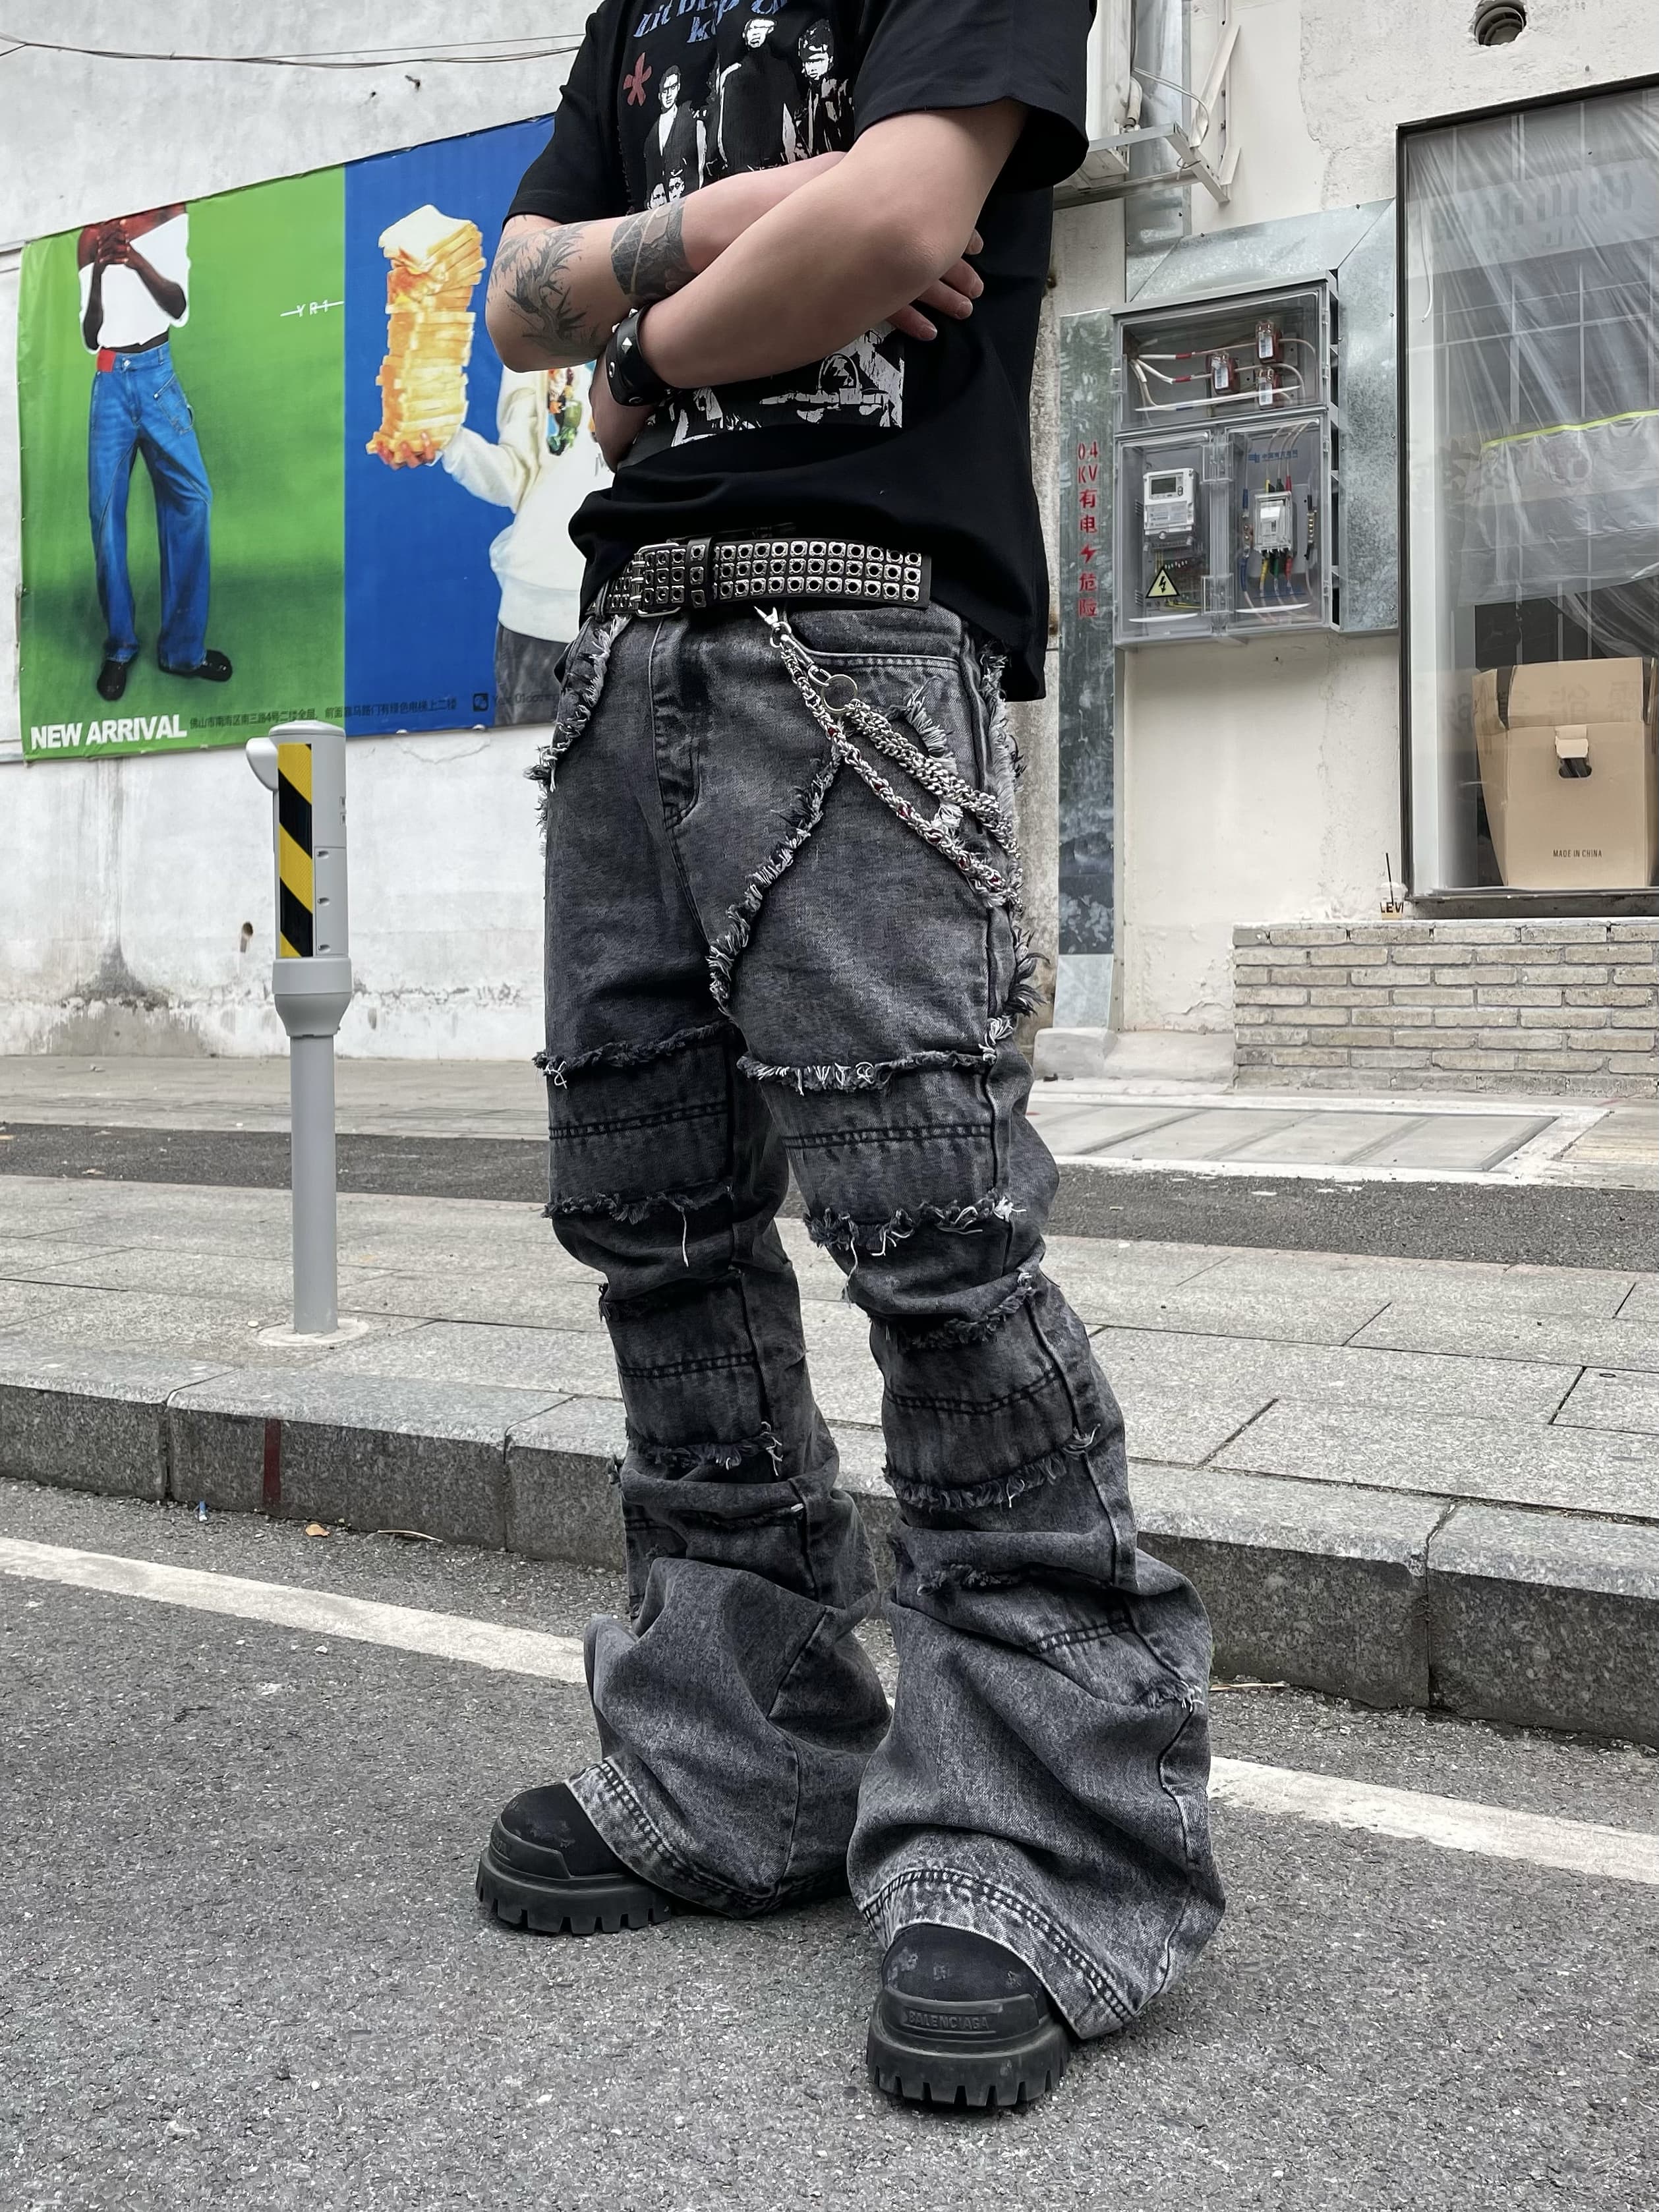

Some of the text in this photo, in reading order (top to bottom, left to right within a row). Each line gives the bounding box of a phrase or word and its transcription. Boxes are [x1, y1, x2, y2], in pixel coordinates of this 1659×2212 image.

[1078, 464, 1098, 484] KV
[30, 714, 187, 750] NEW ARRIVAL
[1553, 849, 1602, 858] MADE IN CHINA
[908, 2010, 989, 2030] BALENCIAGA
